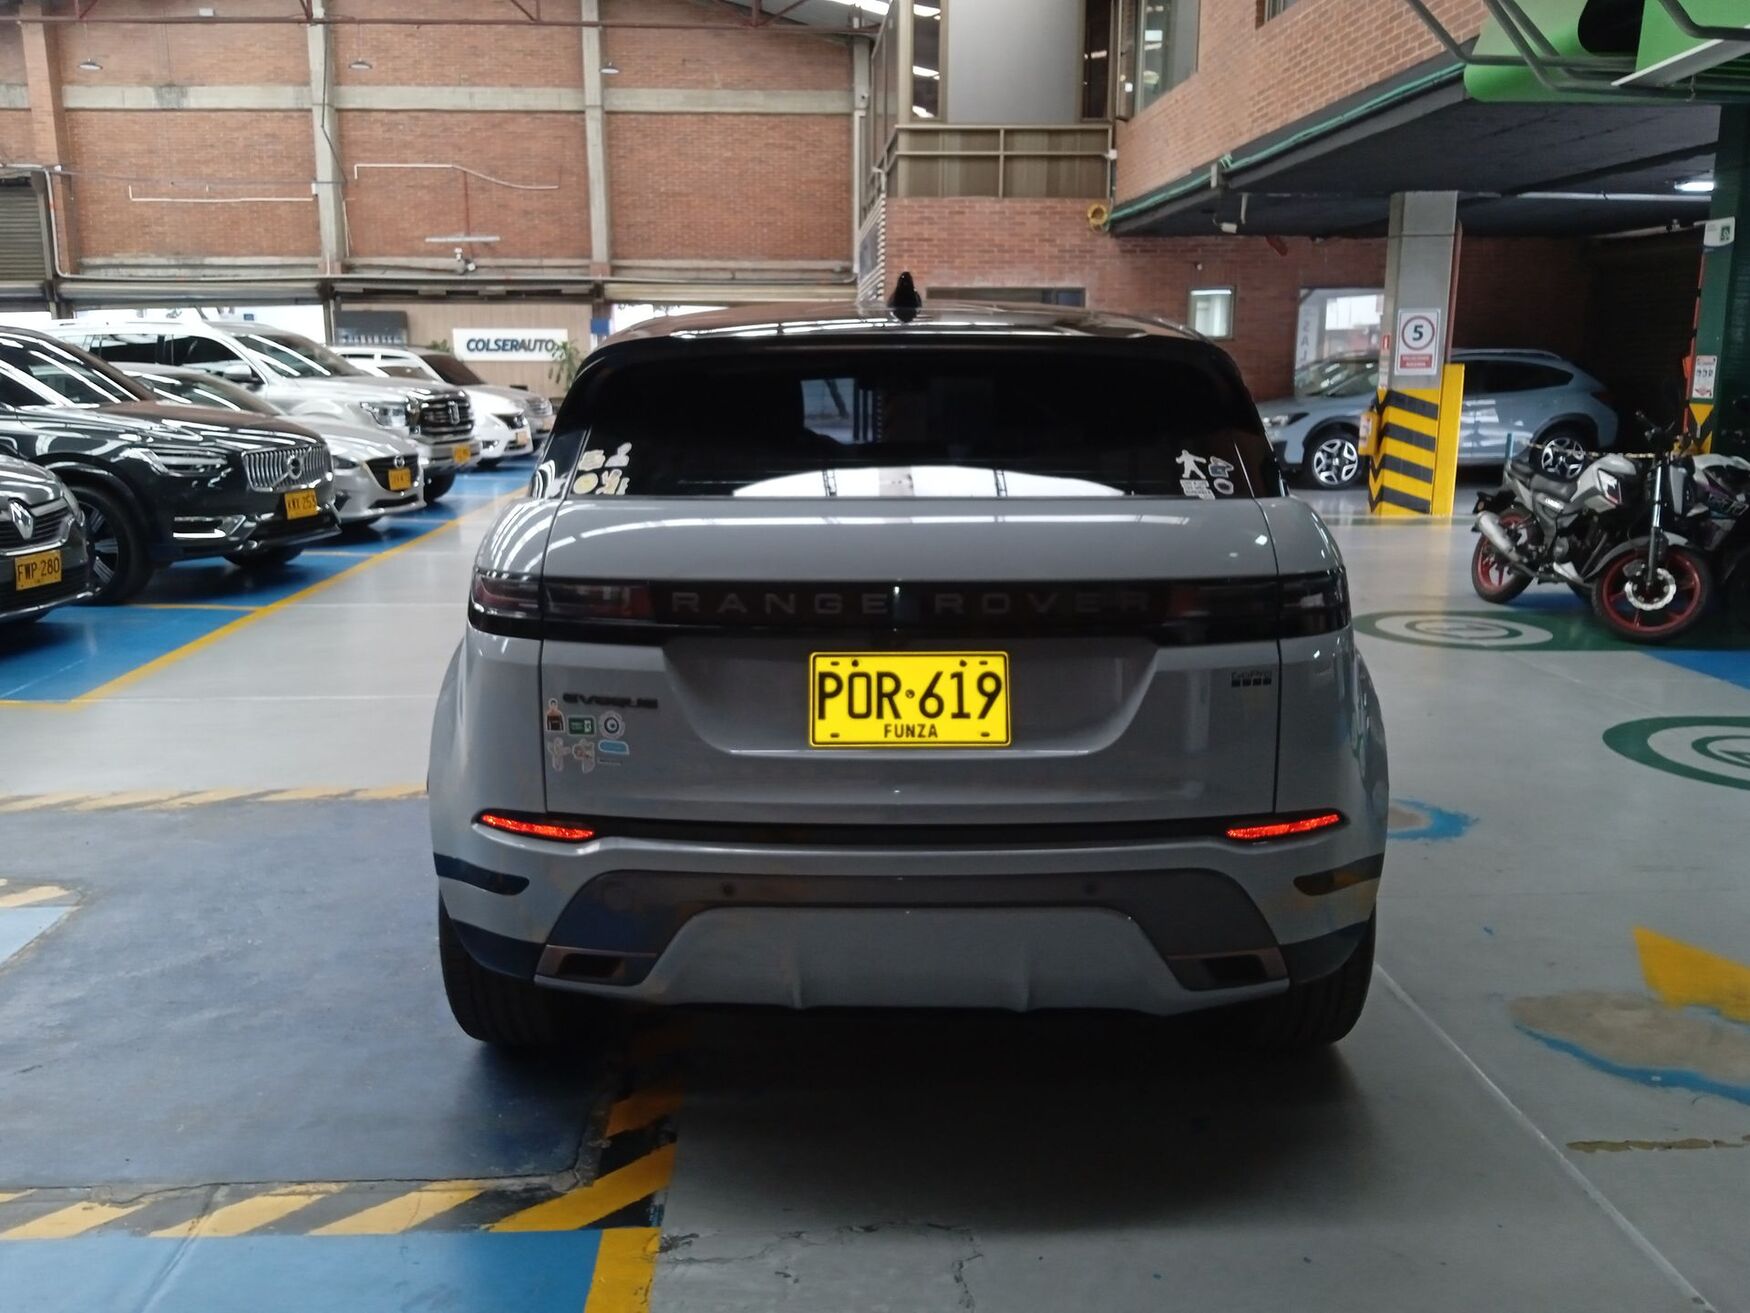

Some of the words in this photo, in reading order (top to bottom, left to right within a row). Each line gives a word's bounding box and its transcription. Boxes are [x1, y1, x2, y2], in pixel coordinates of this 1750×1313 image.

[1412, 324, 1424, 341] 5
[466, 338, 555, 352] COLSERAUTO
[17, 562, 37, 582] FWP
[40, 557, 60, 577] 280
[670, 591, 888, 613] RANGE
[934, 591, 1152, 613] ROVER
[817, 671, 902, 720] POR
[918, 671, 1002, 719] 619
[884, 723, 938, 738] FUNZA
